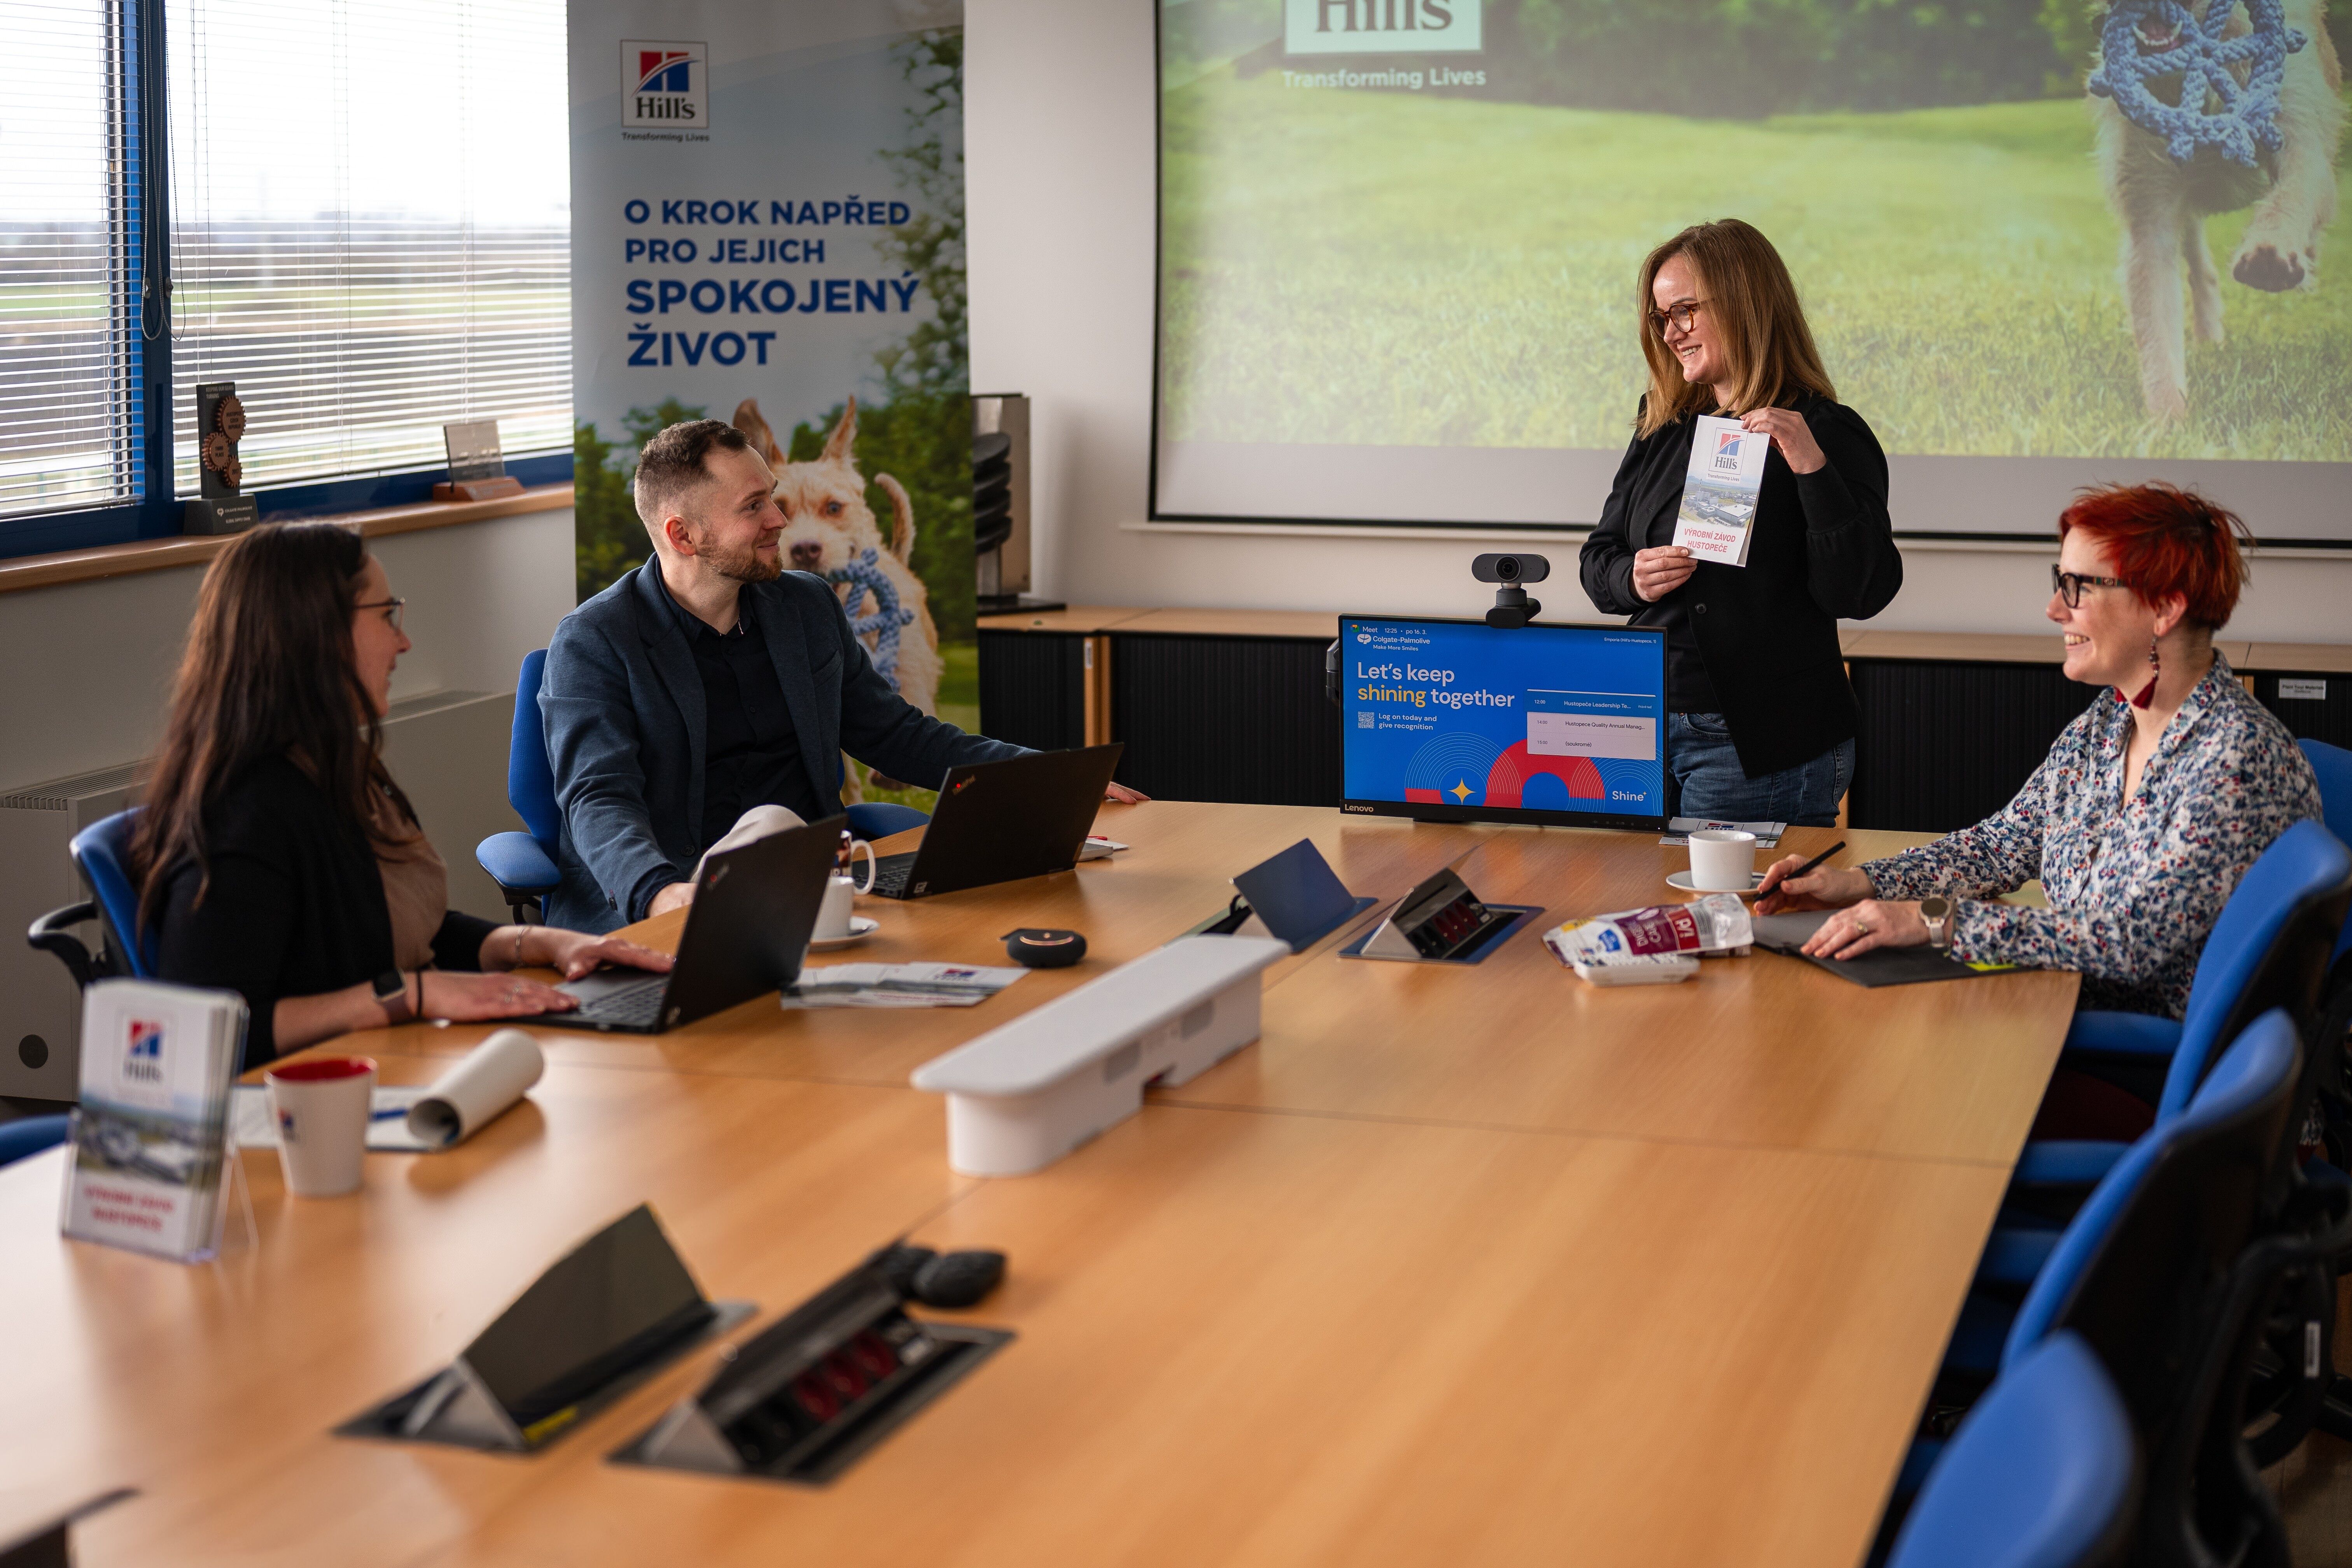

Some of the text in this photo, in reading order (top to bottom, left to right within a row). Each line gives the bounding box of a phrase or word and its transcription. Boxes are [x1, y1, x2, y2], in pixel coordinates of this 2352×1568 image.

[1315, 0, 1452, 32] Hills
[1283, 67, 1486, 89] Transforming Lives
[636, 97, 695, 119] Hill's
[622, 131, 710, 142] Transforming Lives
[624, 195, 910, 225] O KROK NAPŘED
[625, 238, 824, 263] PRO JEJICH
[626, 270, 920, 314] SPOKOJENÝ
[627, 322, 776, 367] ŽIVOT
[1715, 456, 1737, 470] Hill's
[1684, 528, 1736, 542] VÝROBNÍ ZÁVOD
[1687, 540, 1728, 553] HUSTOPEČE
[1373, 636, 1430, 644] Colgate-Palmolive
[1358, 662, 1455, 686] Let's keep
[1358, 684, 1515, 709] shining together
[1612, 790, 1644, 802] Shine
[1345, 804, 1374, 812] Lenovo
